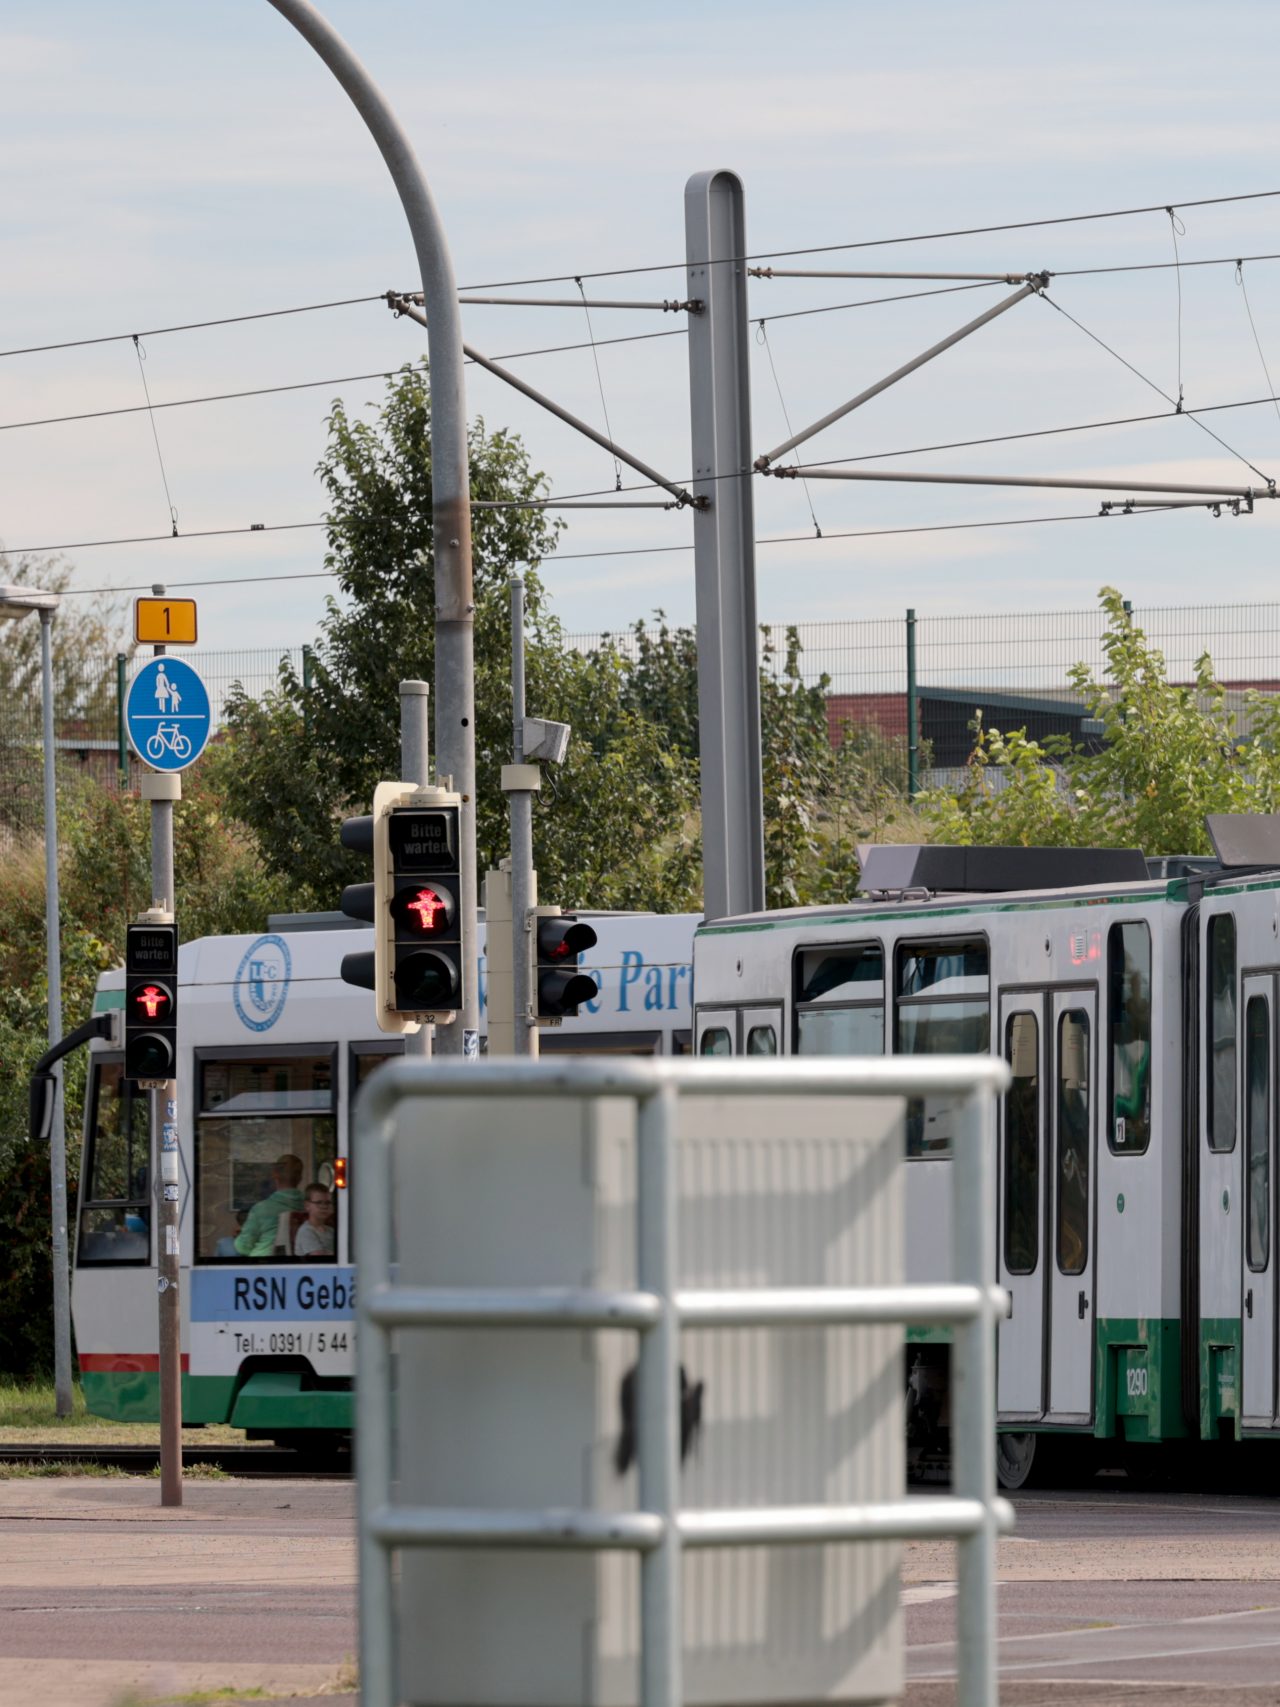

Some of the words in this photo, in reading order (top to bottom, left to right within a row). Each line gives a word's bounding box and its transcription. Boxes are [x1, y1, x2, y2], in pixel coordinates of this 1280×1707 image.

[163, 607, 170, 635] 1
[411, 824, 442, 838] Bitte
[404, 840, 449, 855] warten
[140, 936, 165, 948] Bitte
[135, 949, 169, 960] warten
[424, 1015, 435, 1024] 32
[234, 1276, 286, 1311] RSN
[234, 1333, 264, 1353] Tel.:
[269, 1333, 302, 1353] 0391
[317, 1333, 326, 1352] 5
[331, 1332, 347, 1352] 44
[1126, 1368, 1148, 1396] 1290
